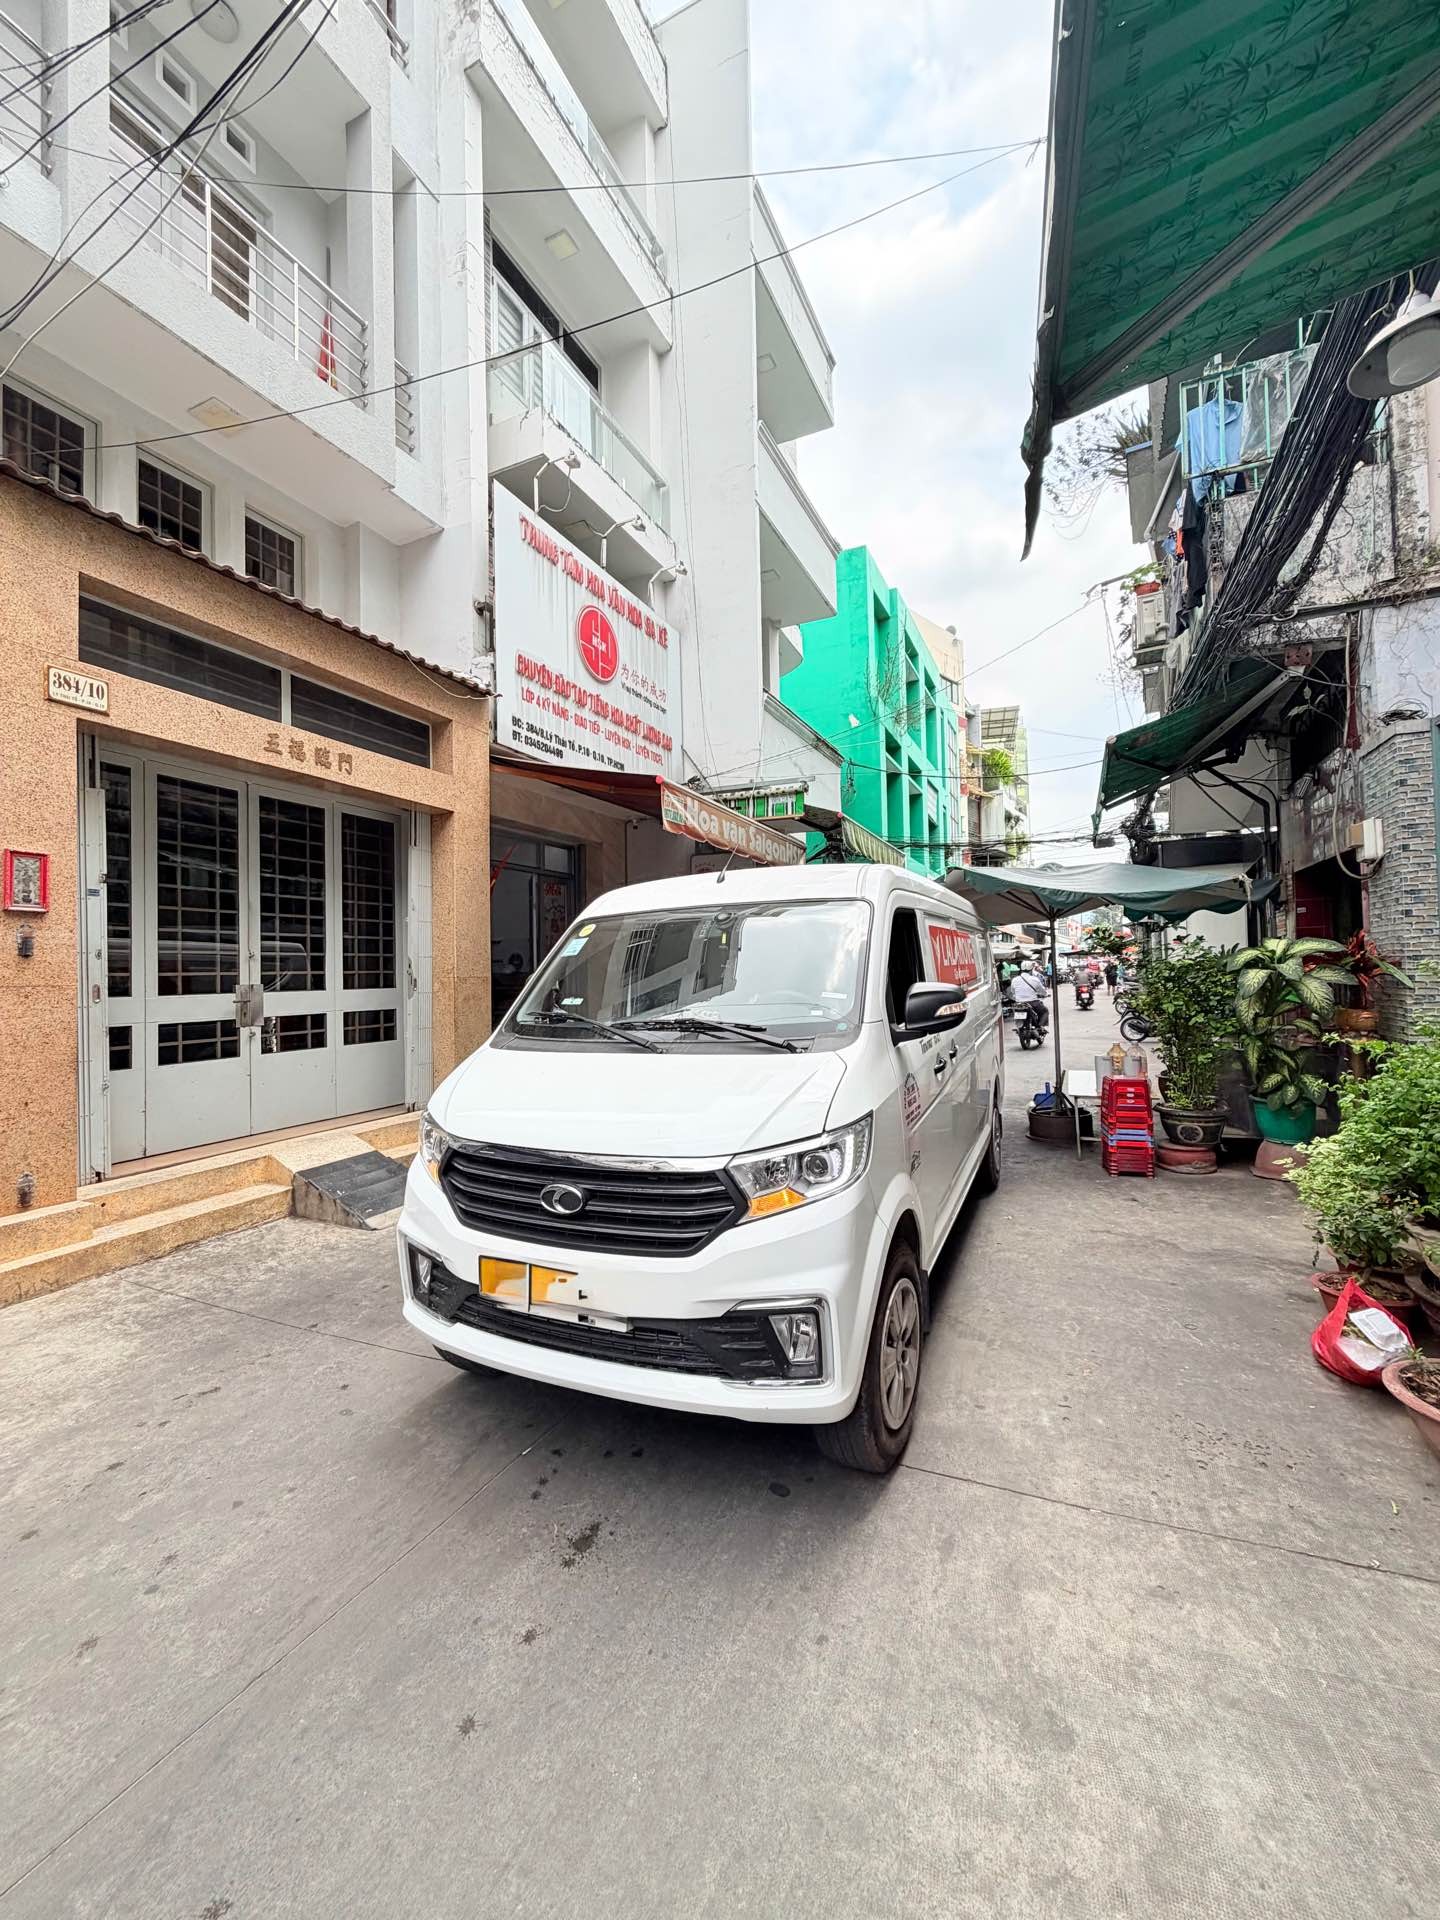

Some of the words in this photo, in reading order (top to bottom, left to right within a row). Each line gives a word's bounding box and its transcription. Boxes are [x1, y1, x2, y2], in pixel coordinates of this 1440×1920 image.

[520, 516, 559, 567] TRUNG
[560, 550, 584, 586] TÂM
[53, 671, 105, 701] 384/10
[517, 654, 552, 691] CHUYÊN
[263, 733, 354, 776] 五福臨門
[686, 797, 719, 836] Hoa
